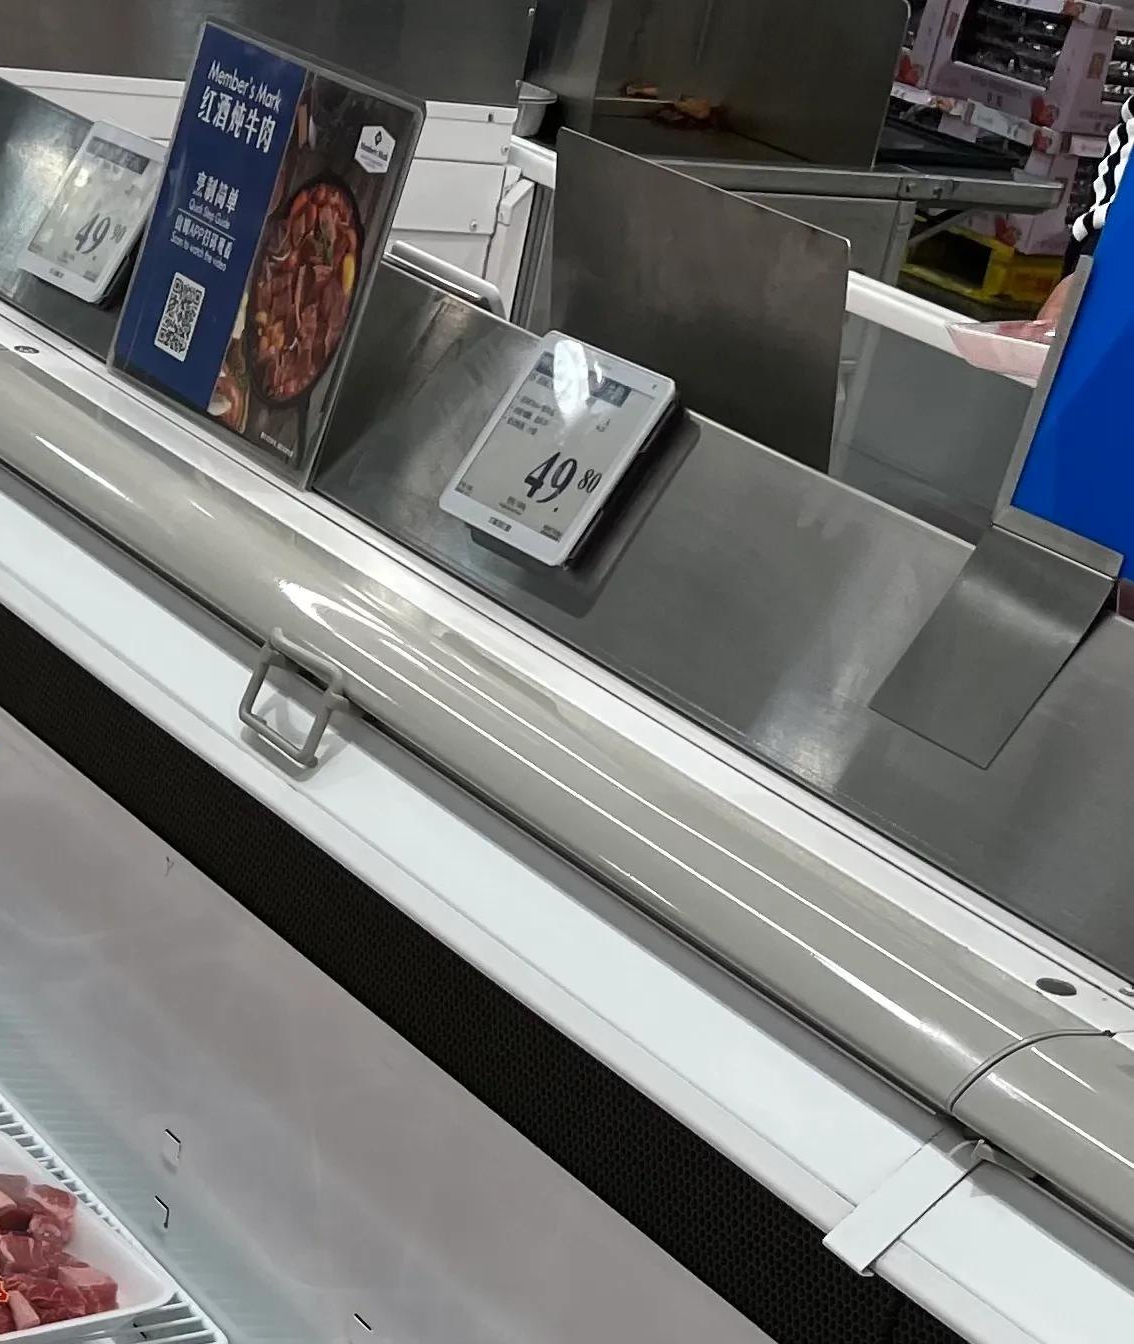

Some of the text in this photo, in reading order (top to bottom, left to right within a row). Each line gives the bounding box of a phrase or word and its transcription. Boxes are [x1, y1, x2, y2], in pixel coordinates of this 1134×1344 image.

[208, 60, 282, 113] Member's Mark
[198, 86, 276, 153] 红酒炖牛肉
[192, 171, 239, 213] 烹制简单
